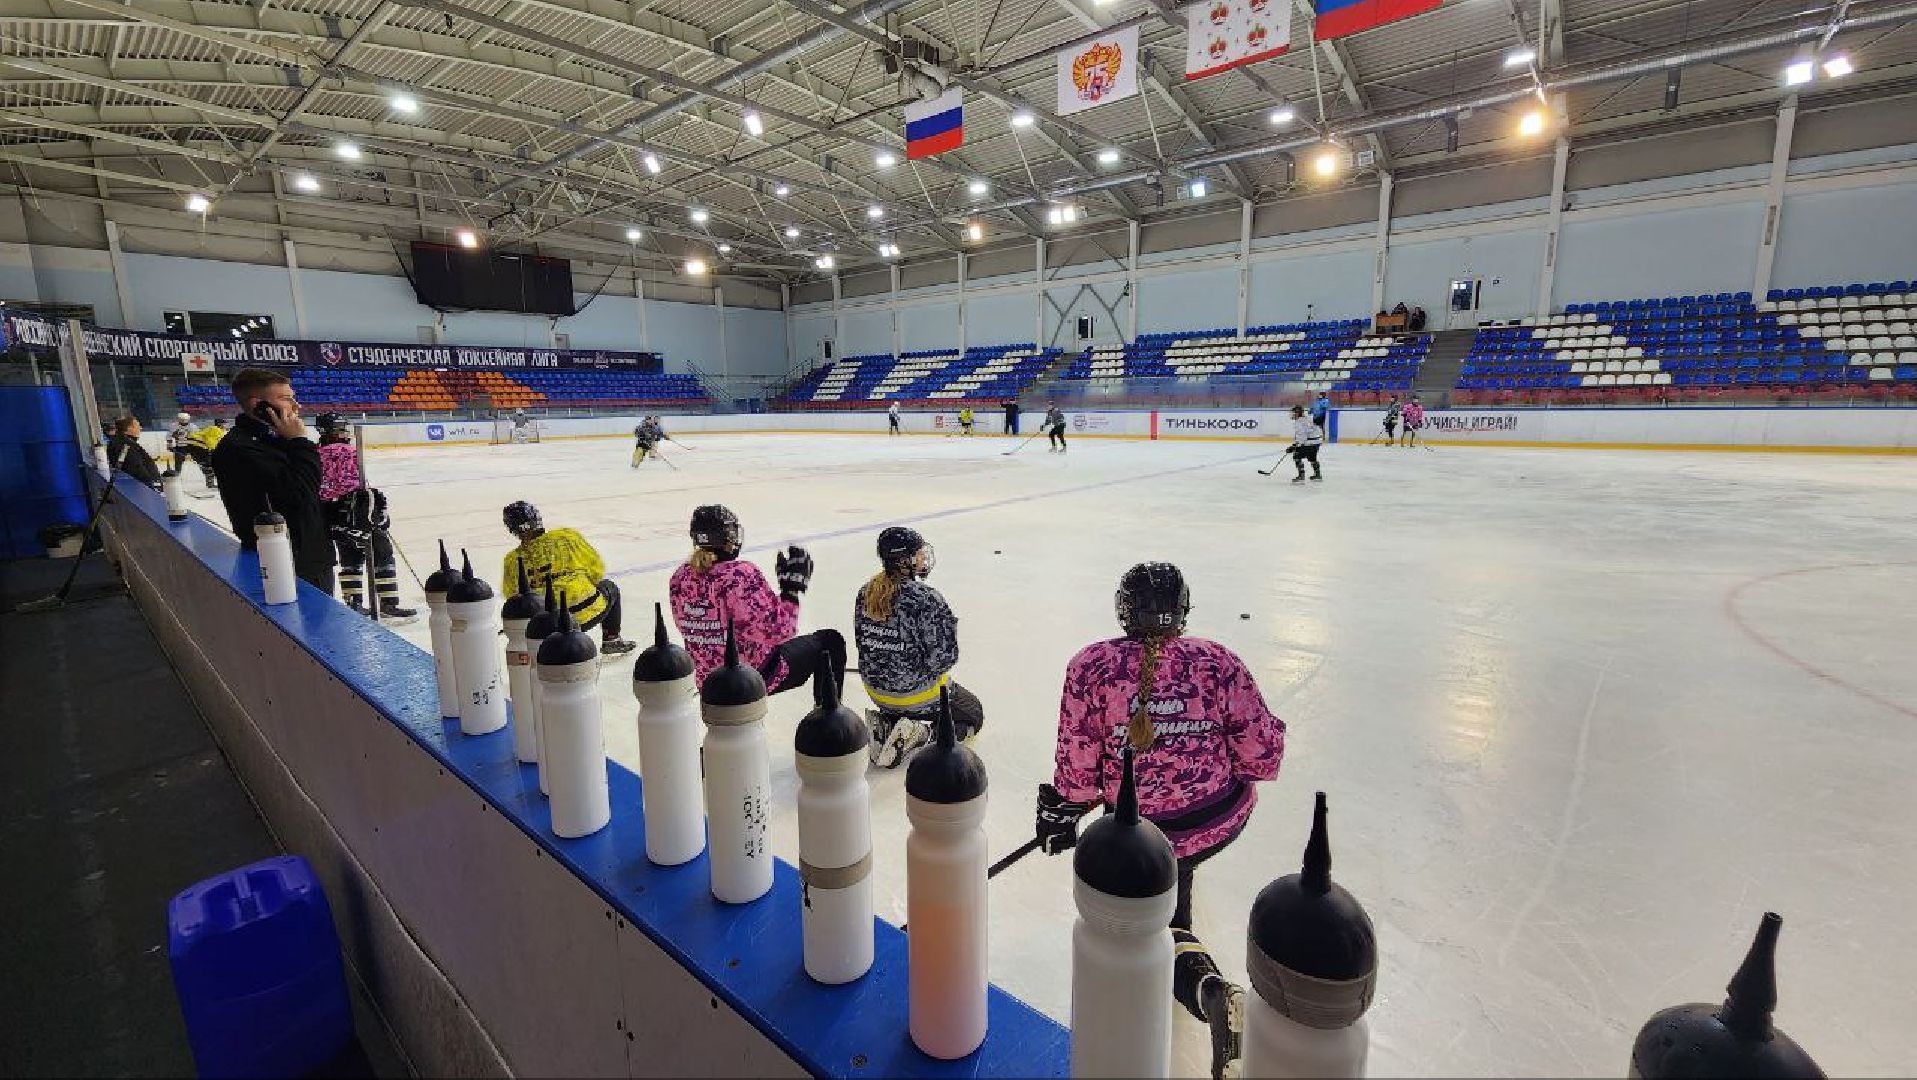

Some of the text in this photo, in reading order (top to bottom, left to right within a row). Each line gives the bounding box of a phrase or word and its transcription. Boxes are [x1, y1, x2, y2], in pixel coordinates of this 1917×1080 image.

[145, 337, 249, 361] СПОРТИВНЫЙ
[252, 343, 299, 363] СОЮЗ
[347, 346, 450, 366] СТУДЕНЧЕСКАЯ
[457, 349, 526, 367] ХОККЕЙНАЯ
[532, 351, 558, 367] ЛИГА
[1165, 418, 1259, 429] ТИНЬКОФФ
[1158, 613, 1173, 627] 15
